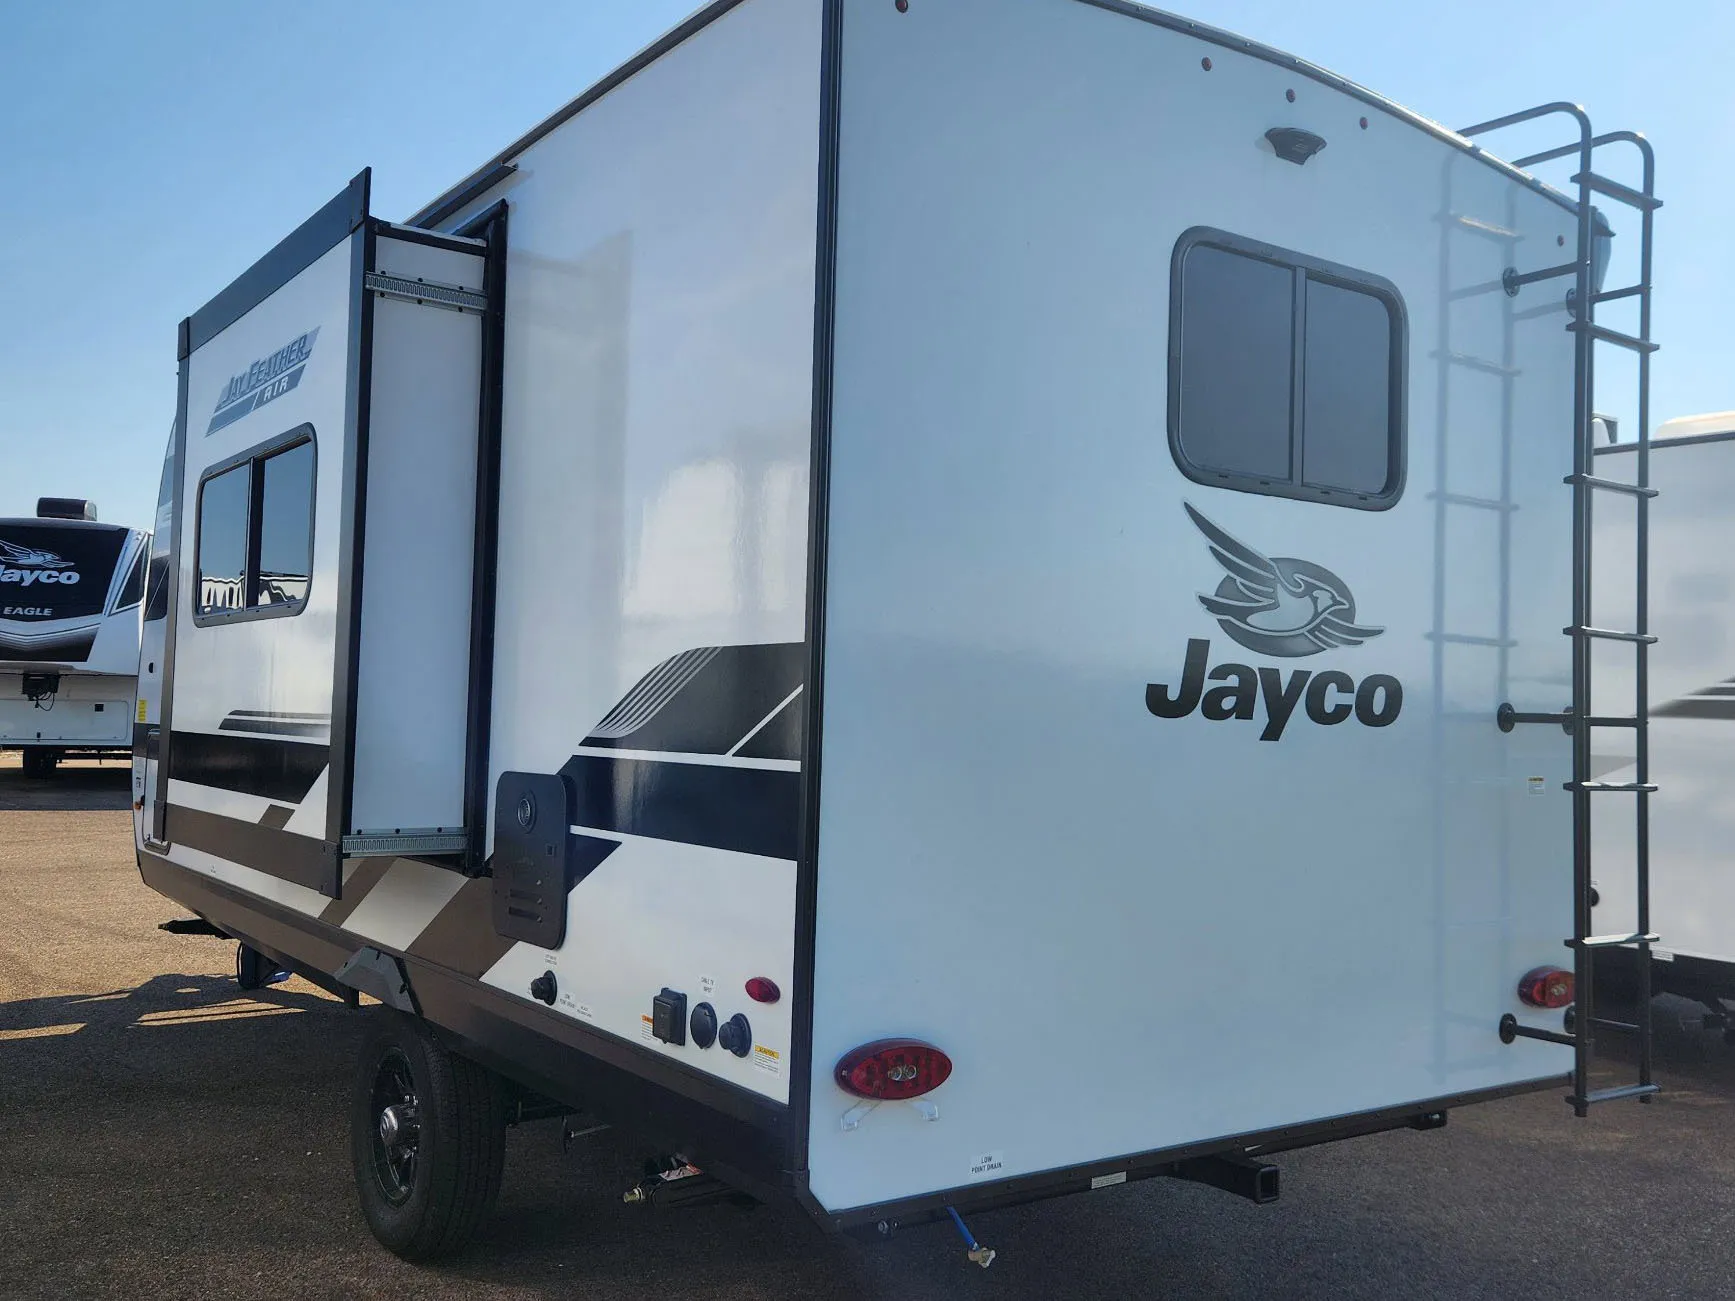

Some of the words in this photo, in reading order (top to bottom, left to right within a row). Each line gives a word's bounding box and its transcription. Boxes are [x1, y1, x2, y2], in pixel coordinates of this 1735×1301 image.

[244, 334, 312, 391] FEATHER
[263, 376, 289, 402] AIR
[0, 564, 80, 586] ayco
[3, 606, 53, 616] EAGLE
[1145, 638, 1403, 741] Jayco
[971, 1164, 987, 1174] POINT
[986, 1161, 1002, 1171] DRAIN
[981, 1155, 993, 1164] LOW
